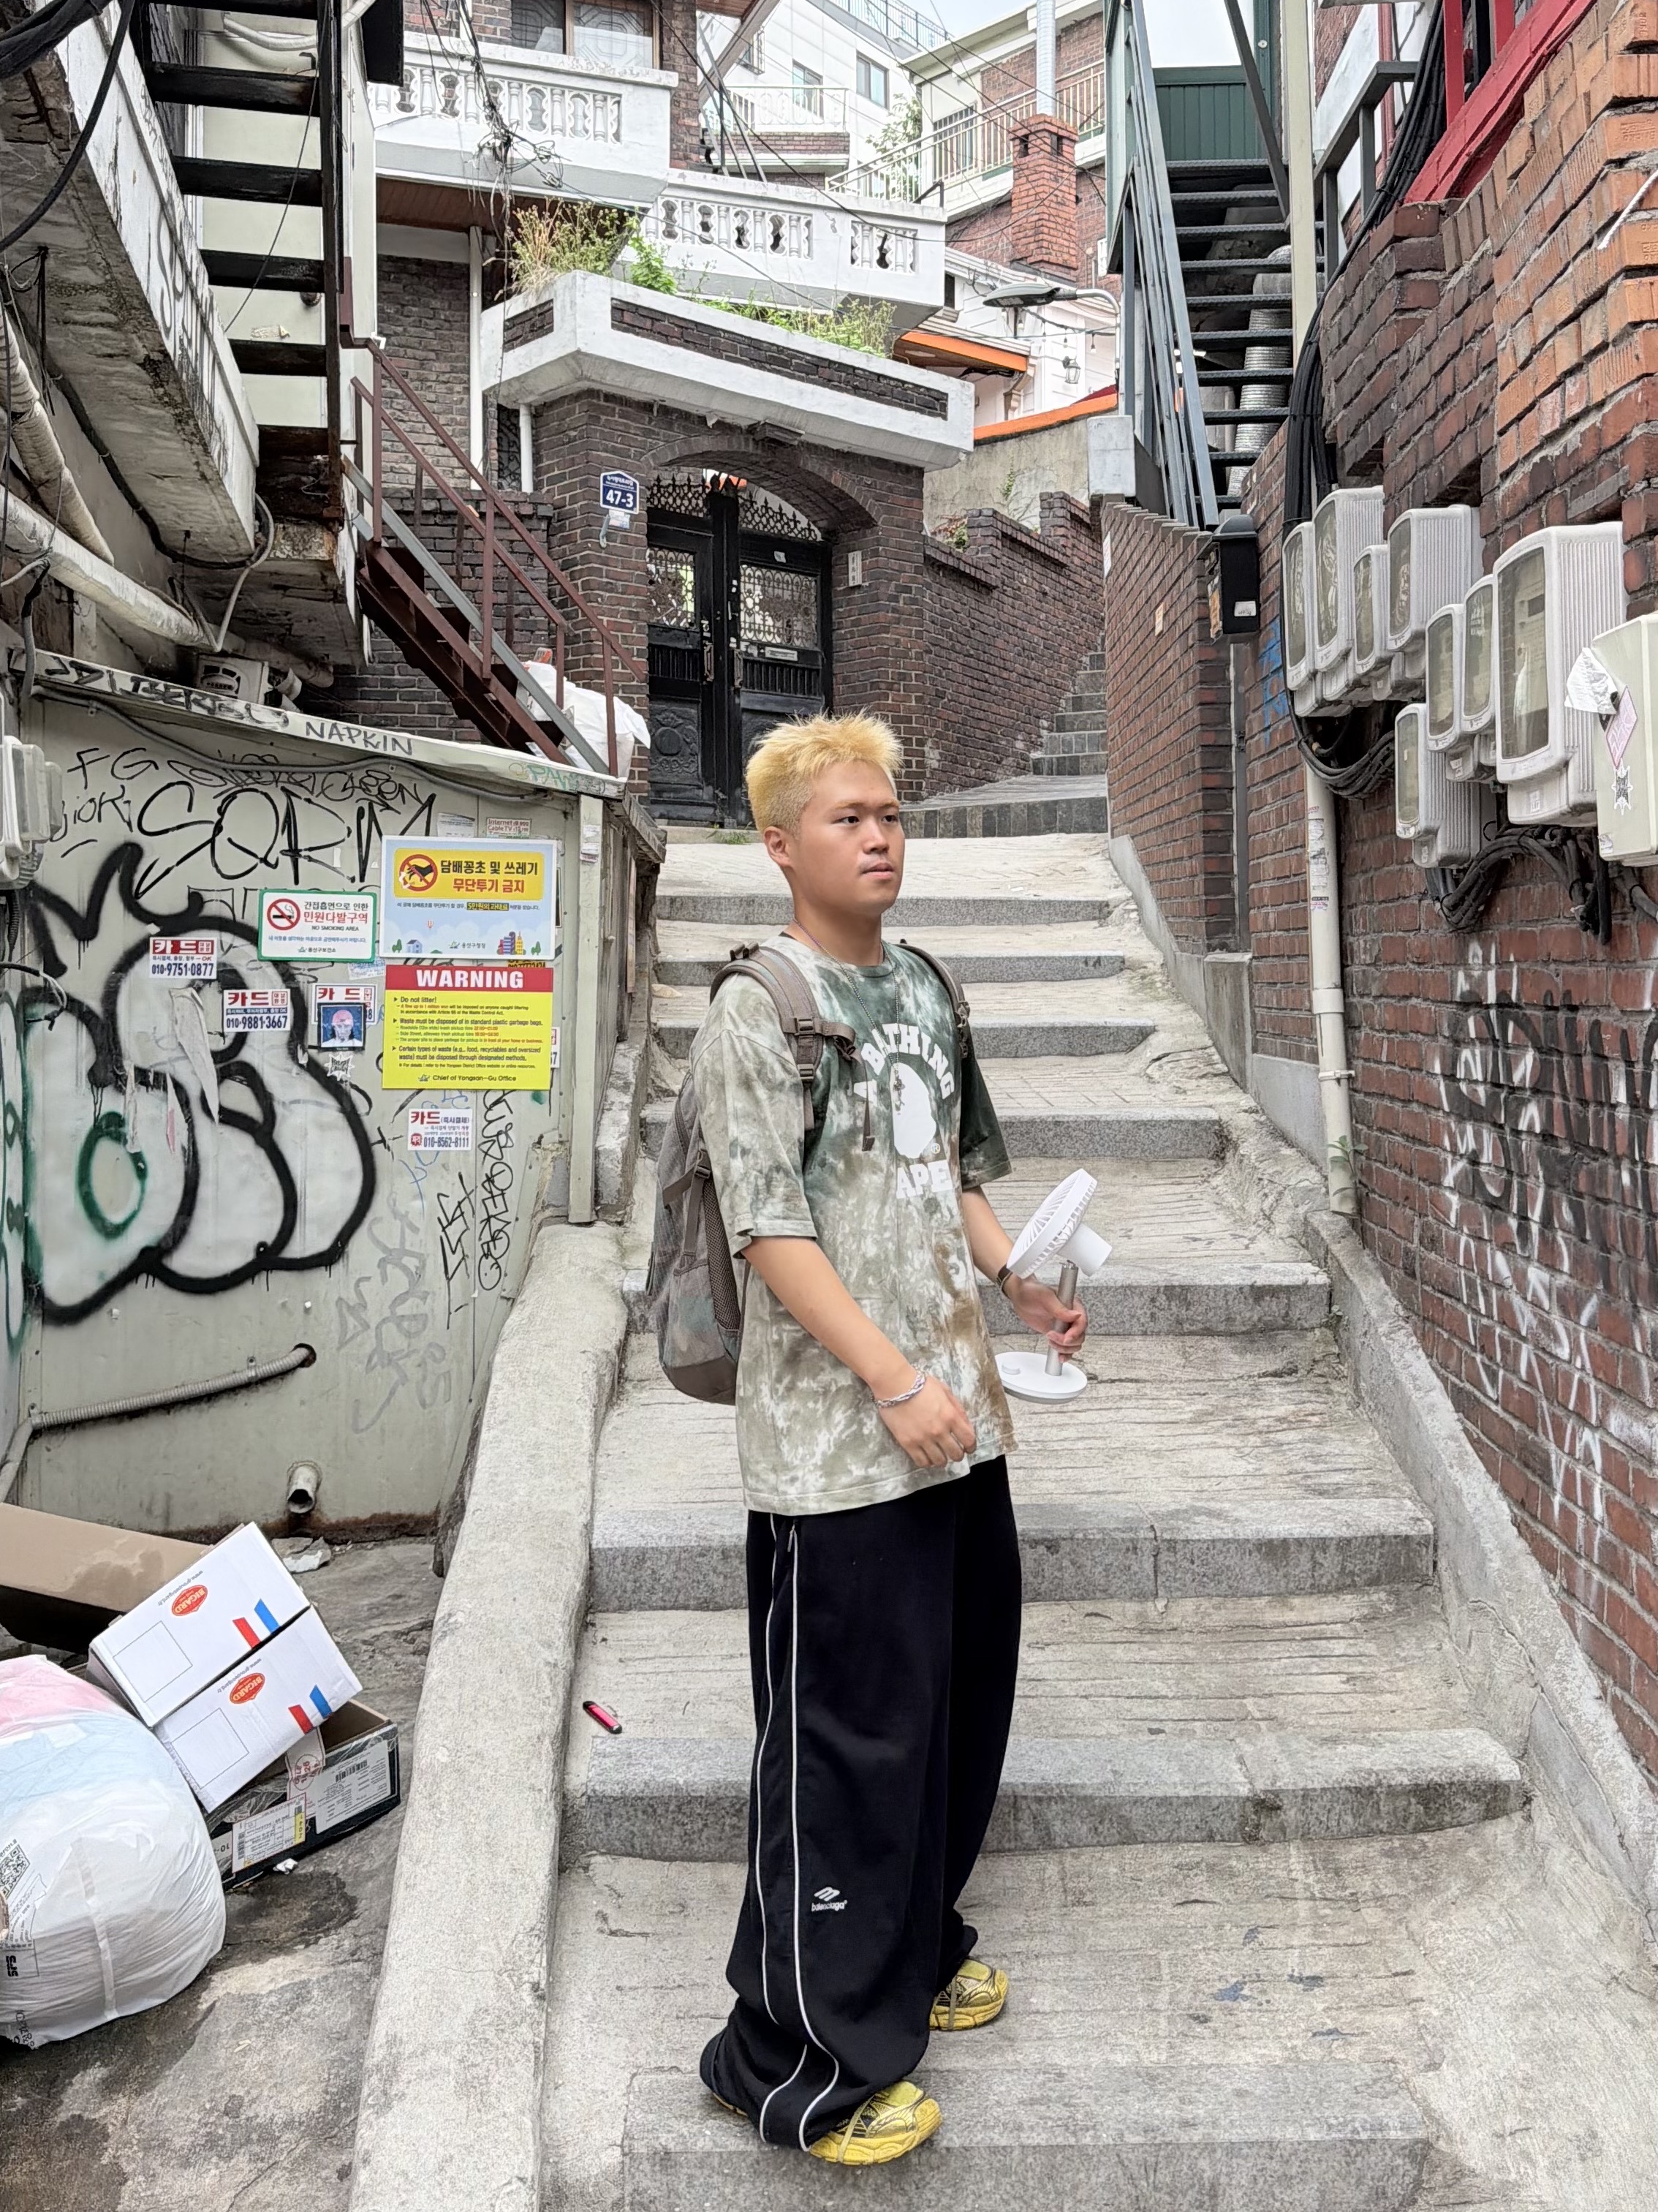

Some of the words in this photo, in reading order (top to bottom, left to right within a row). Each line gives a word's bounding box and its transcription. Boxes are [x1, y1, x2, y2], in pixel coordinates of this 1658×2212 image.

[606, 489, 633, 507] 47-3
[304, 720, 414, 756] NAPKIN
[440, 860, 486, 874] 담배꽁초
[490, 861, 500, 875] 및
[504, 861, 538, 875] 쓰레기
[453, 878, 499, 893] 무단투기
[502, 879, 525, 894] 금지
[304, 902, 350, 910] 간접흡연으로
[353, 903, 368, 911] 인한
[303, 912, 368, 924] 민원다발구역
[155, 940, 197, 954] 카드
[416, 969, 524, 989] WARNING
[228, 992, 269, 1006] 카드
[861, 1023, 954, 1099] BATHING
[411, 1111, 440, 1125] 카드
[896, 1159, 953, 1199] APE
[173, 1588, 206, 1615] BIGARD
[232, 1676, 263, 1702] BIGARD
